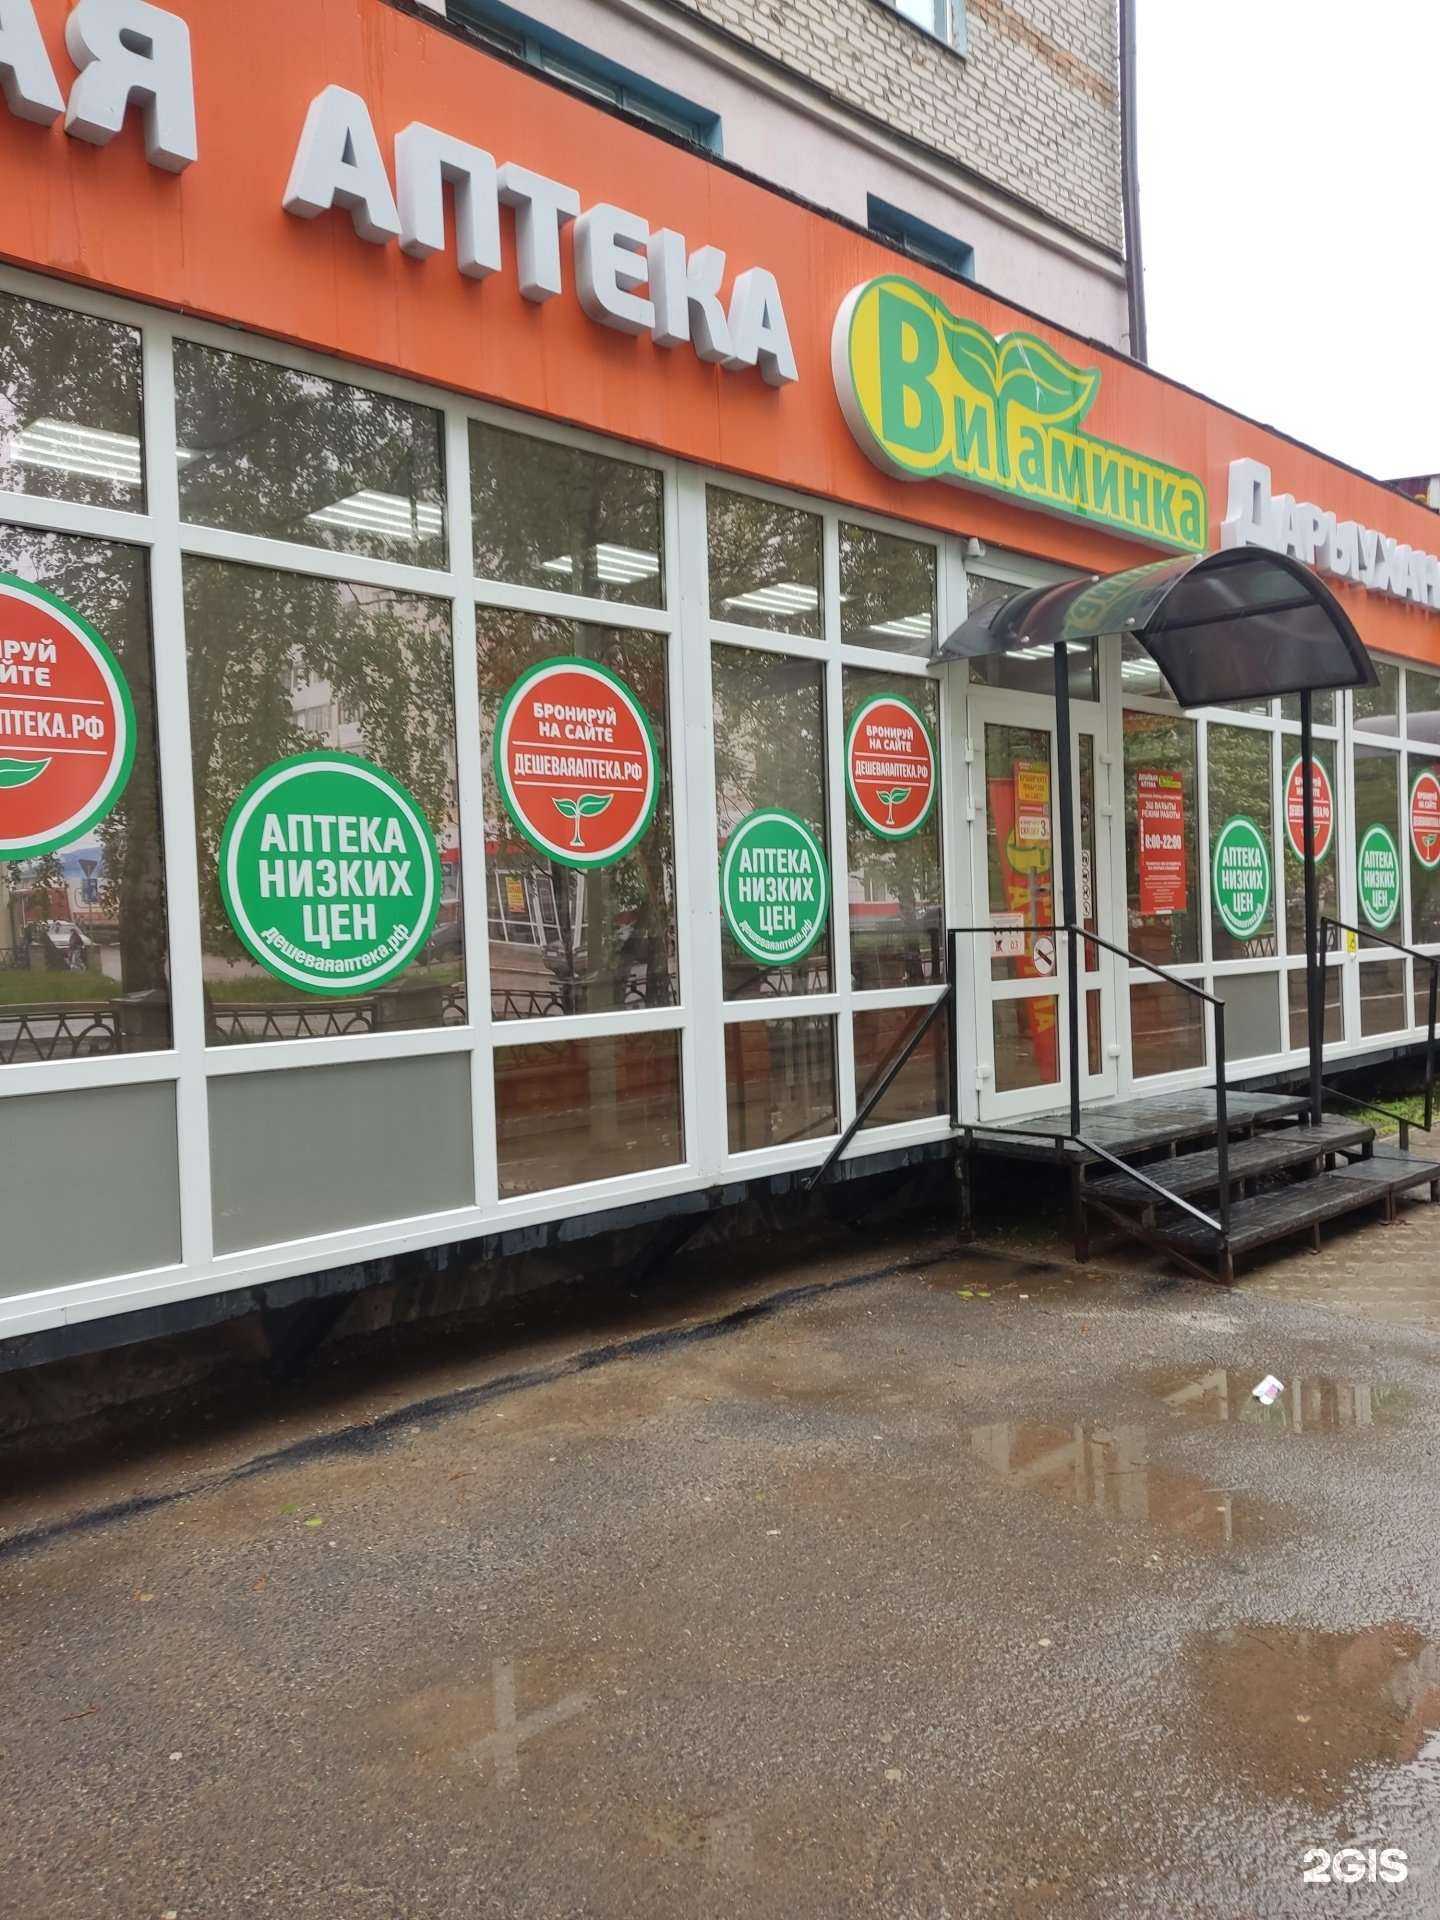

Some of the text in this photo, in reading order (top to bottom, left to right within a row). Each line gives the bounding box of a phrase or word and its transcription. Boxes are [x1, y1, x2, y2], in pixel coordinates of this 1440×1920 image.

[282, 84, 798, 388] АПТЕКА
[876, 286, 1204, 547] Витаминка
[0, 638, 57, 663] РУЙ
[533, 702, 617, 726] БРОНИРУЙ
[539, 721, 614, 743] НА САЙТЕ
[866, 725, 914, 741] БРОНИРУЙ
[869, 738, 912, 752] НА САЙТЕ
[514, 752, 643, 782] ДЕШЕВАЯАПТЕКА.РФ
[260, 813, 407, 854] АПТЕКА
[739, 847, 812, 874] АПТЕКА
[1222, 846, 1261, 867] АПТЕКА
[1364, 850, 1394, 869] АПТЕКА
[258, 859, 414, 898] НИЗКИХ
[738, 877, 814, 902] НИЗКИХ
[1222, 869, 1263, 890] НИЗКИХ
[1364, 870, 1395, 889] НИЗКИХ
[1233, 892, 1254, 917] ЦЕН
[1372, 889, 1388, 911] ЦЕН
[303, 904, 378, 949] ЦЕН
[759, 905, 797, 936] ЦЕН
[260, 923, 411, 973] дешеваяаптека.рф
